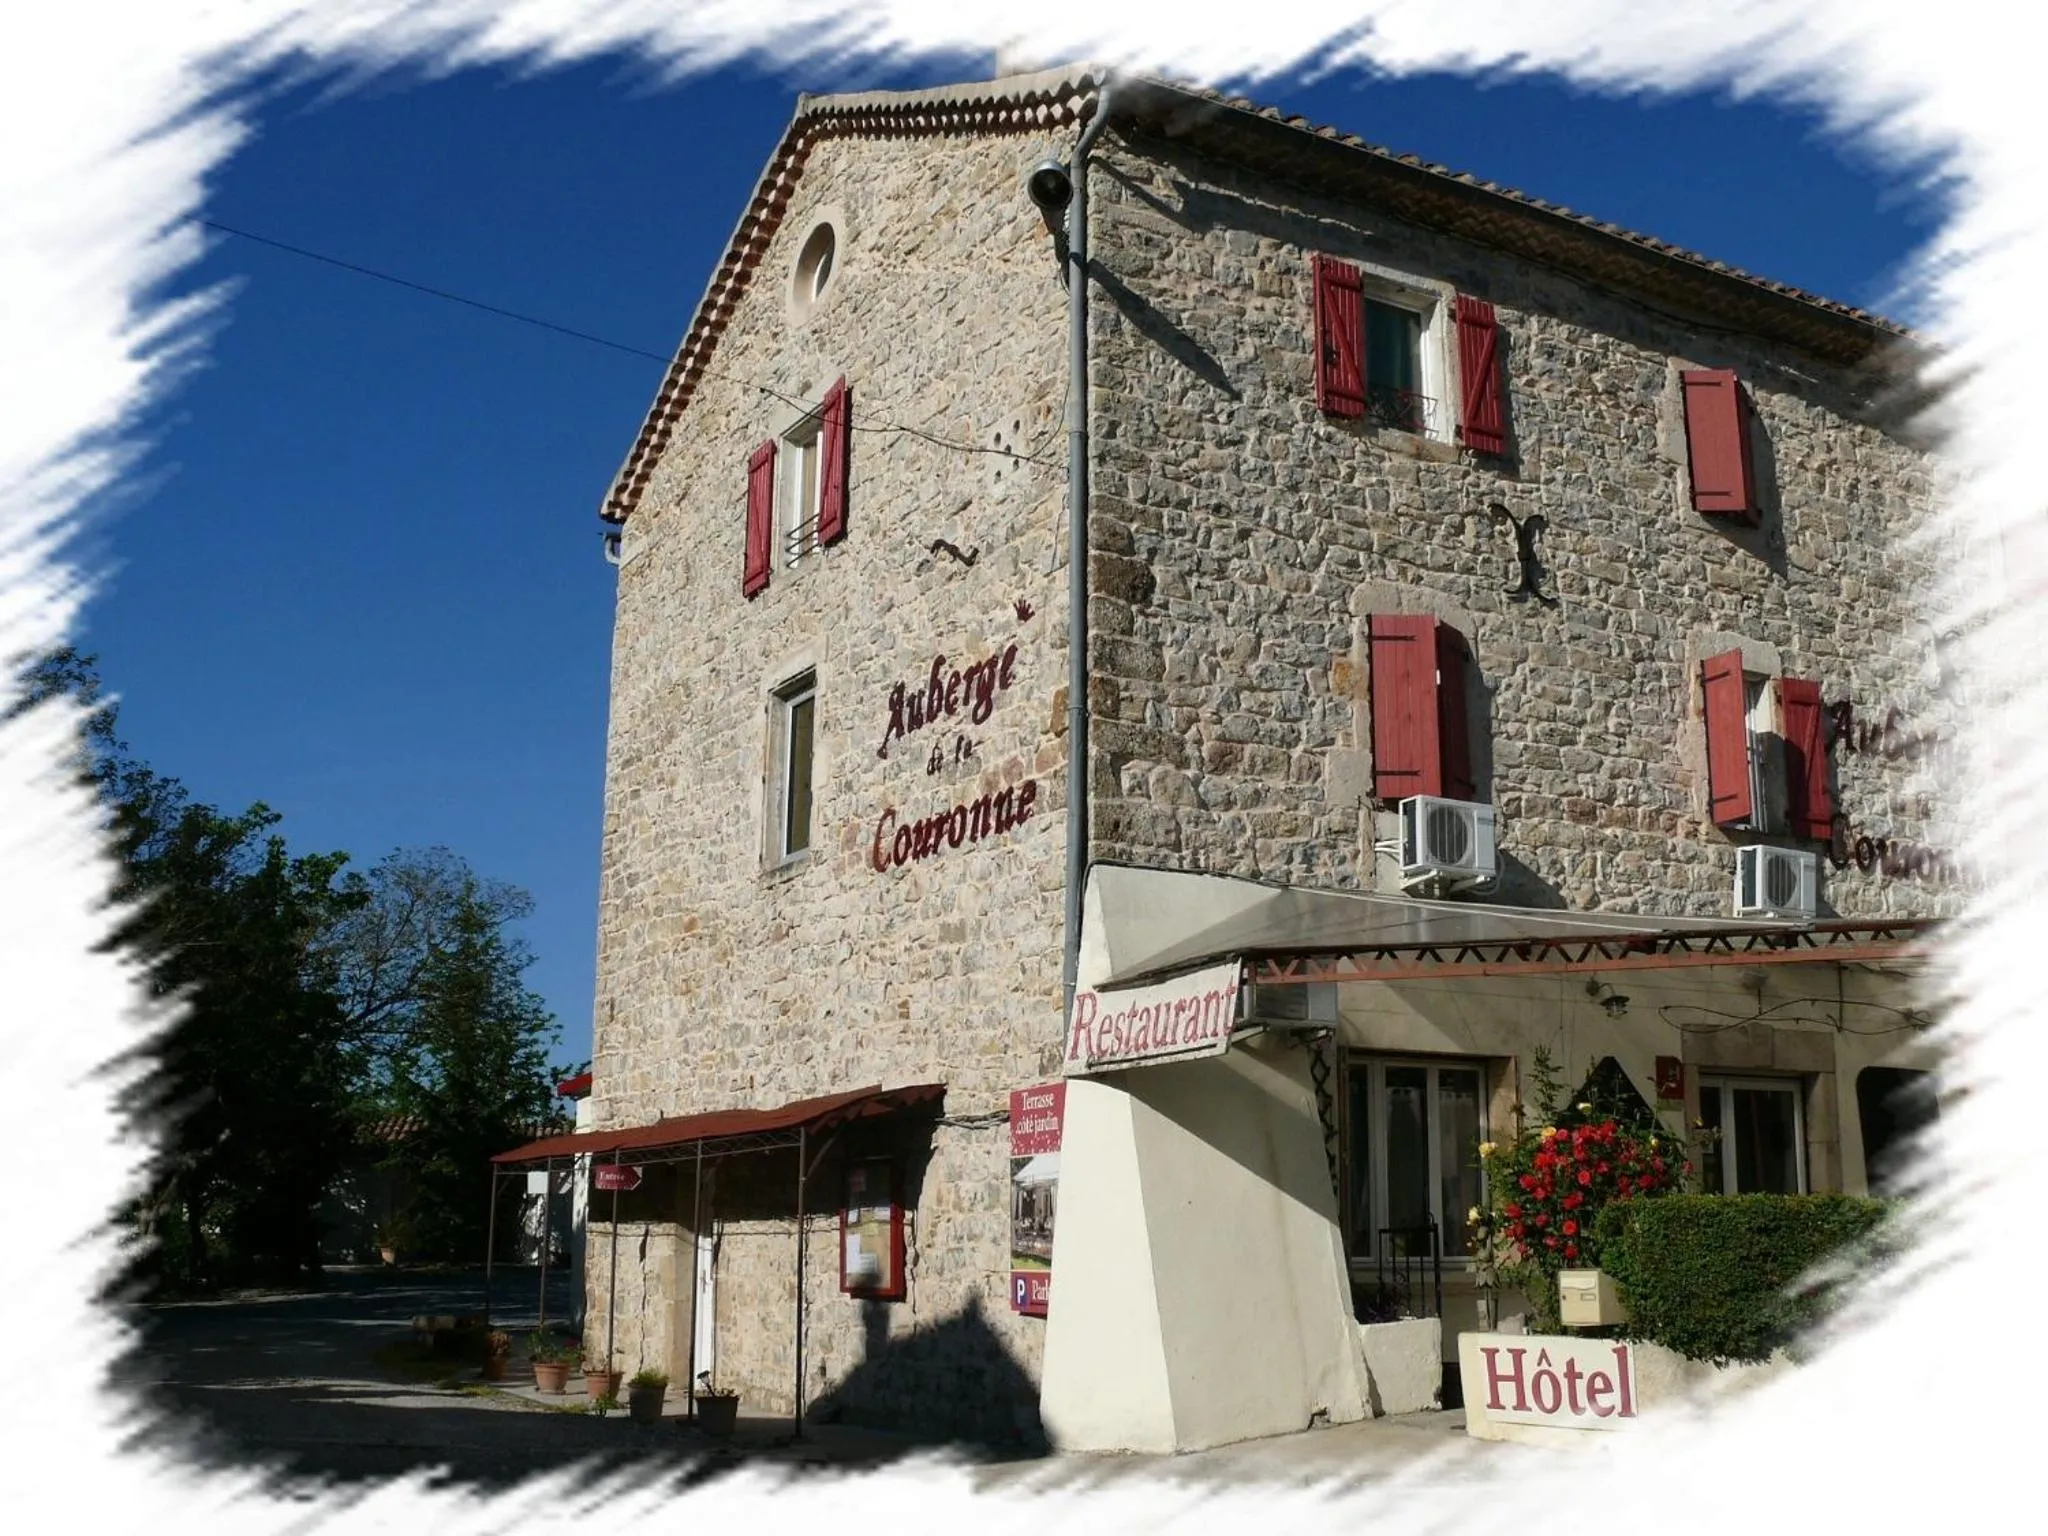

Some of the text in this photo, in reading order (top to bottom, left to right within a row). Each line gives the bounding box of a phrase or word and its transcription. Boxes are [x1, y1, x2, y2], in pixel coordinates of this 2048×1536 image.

[877, 643, 1018, 759] Auberge
[1830, 701, 1953, 768] Auber
[872, 779, 1037, 873] Couronne
[1067, 974, 1238, 1060] Restaurant
[1020, 1091, 1055, 1111] Terrasse
[1034, 1109, 1059, 1137] jardin
[1016, 1278, 1025, 1305] P
[1480, 1345, 1637, 1418] Hôtel
